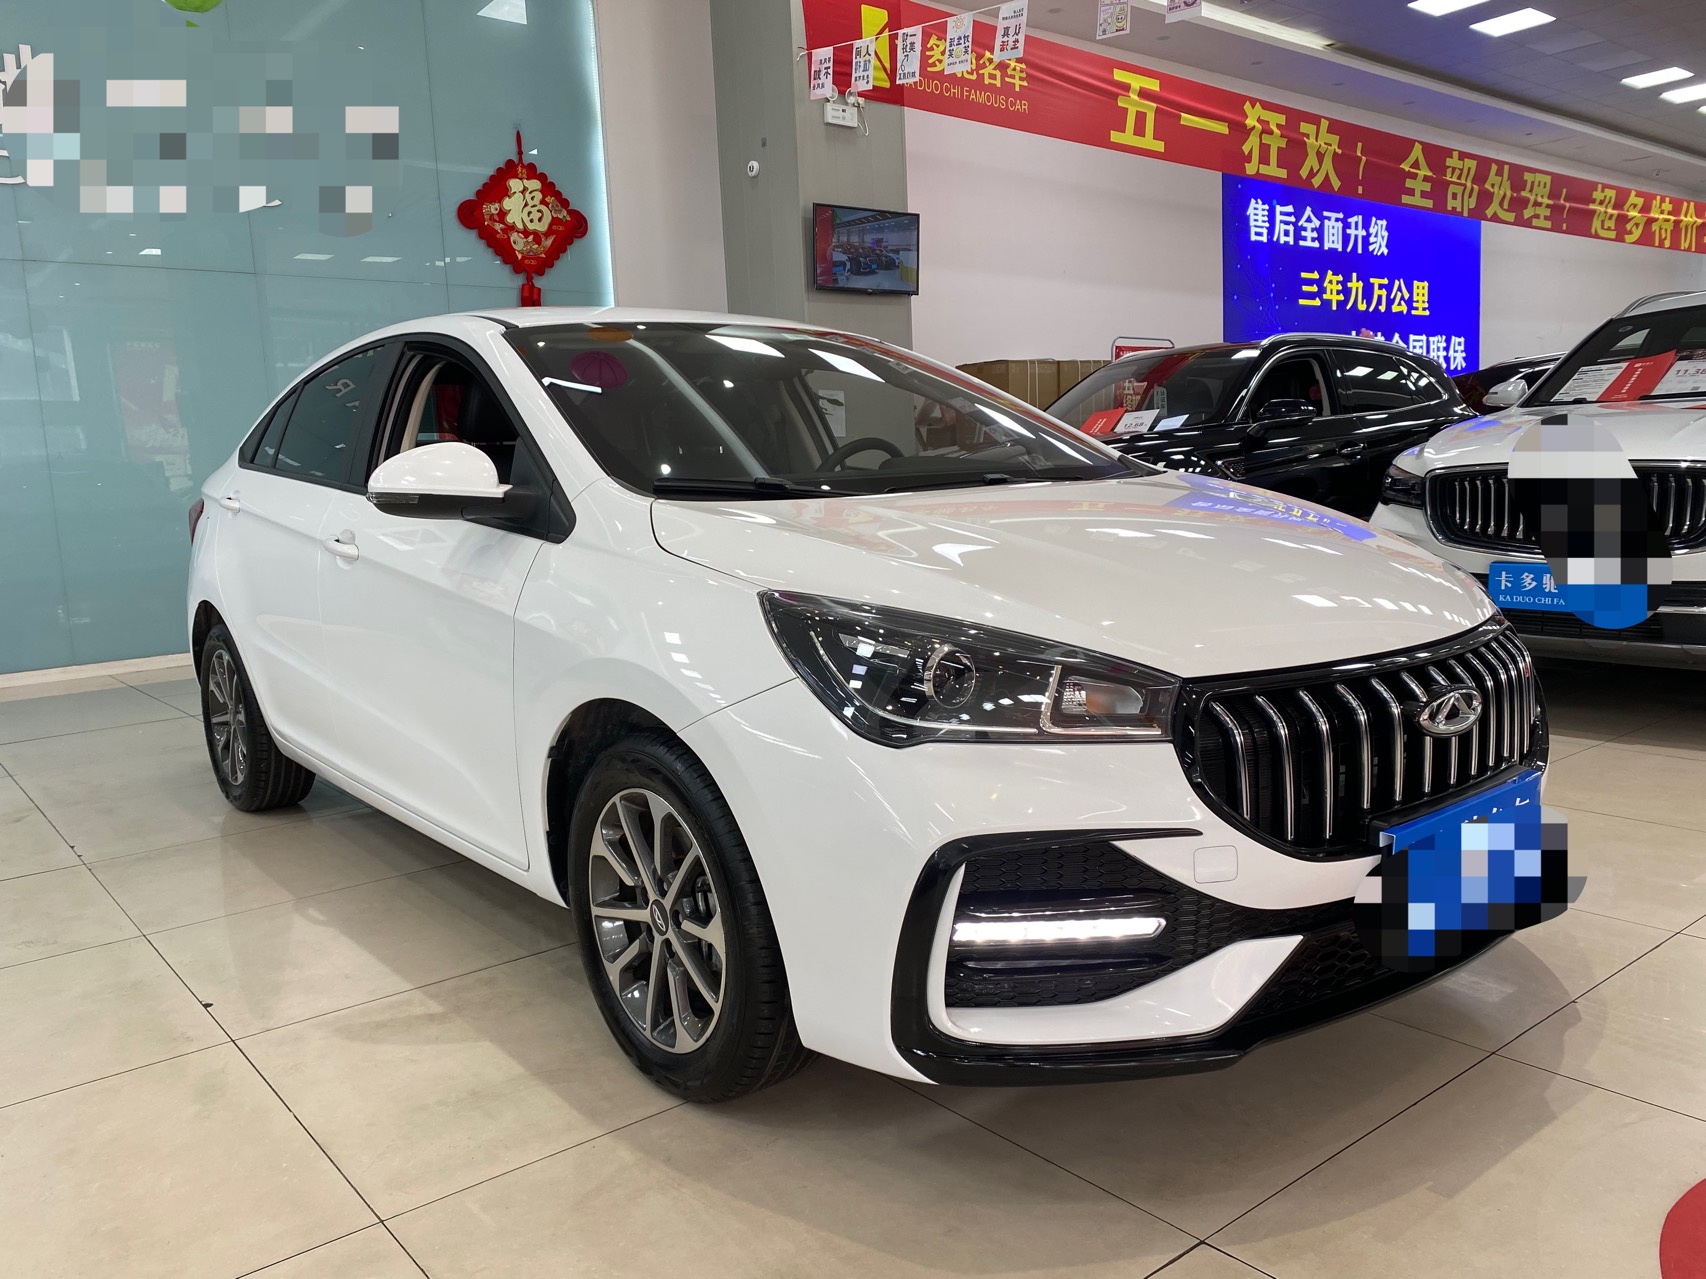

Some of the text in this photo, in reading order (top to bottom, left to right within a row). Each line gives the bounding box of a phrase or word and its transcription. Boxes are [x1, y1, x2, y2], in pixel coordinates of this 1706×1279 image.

[917, 76, 941, 94] DUO
[943, 82, 961, 99] CHI
[963, 87, 1006, 109] FAMOUS
[1008, 97, 1029, 114] CAR
[501, 178, 552, 233] 福
[1246, 198, 1389, 256] 售后全面升级
[1298, 269, 1430, 316] 三年九万公里
[1498, 594, 1511, 602] KA
[1513, 595, 1534, 603] DUO
[1535, 596, 1552, 605] CHI
